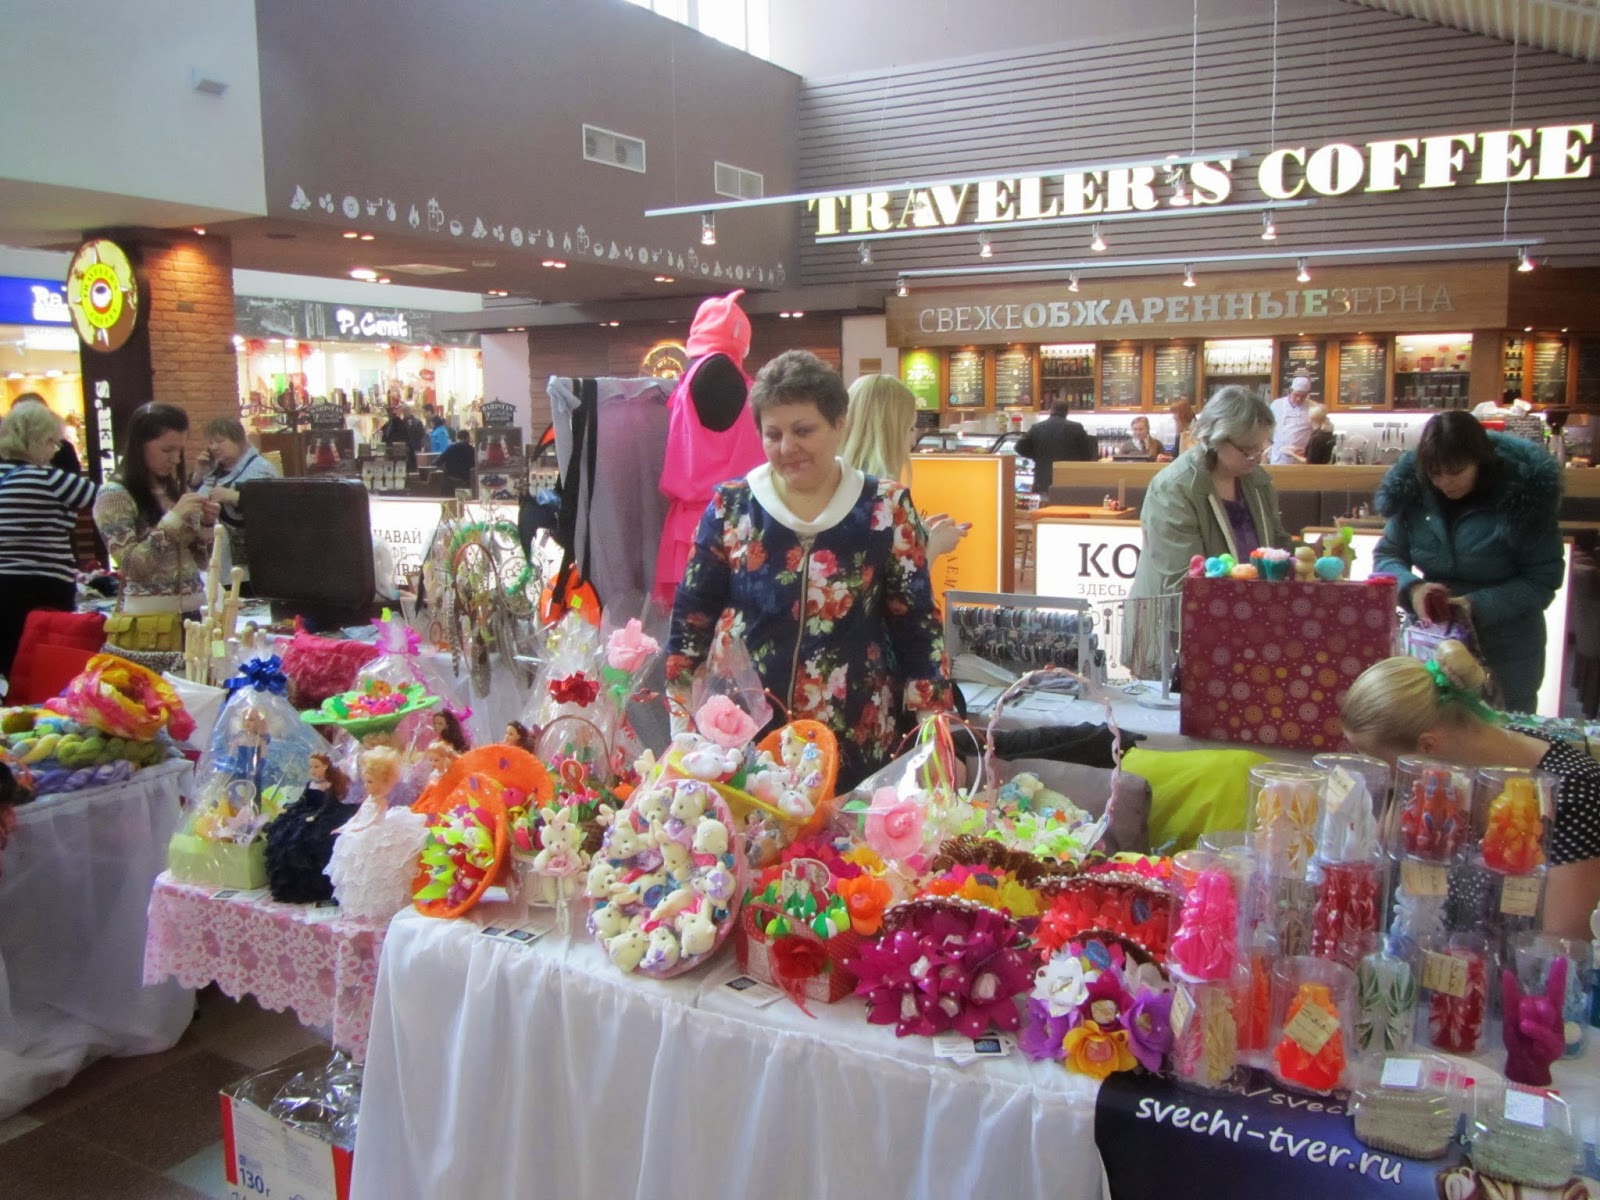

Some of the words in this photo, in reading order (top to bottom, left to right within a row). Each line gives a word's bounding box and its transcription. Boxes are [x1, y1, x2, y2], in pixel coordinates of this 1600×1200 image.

[808, 155, 1232, 235] TRAVELER'S
[1258, 123, 1593, 200] COFFEE
[1077, 583, 1127, 598] ЗДЕСЬ
[1135, 1097, 1402, 1184] svechi-tver.ru
[239, 1167, 265, 1194] 130
